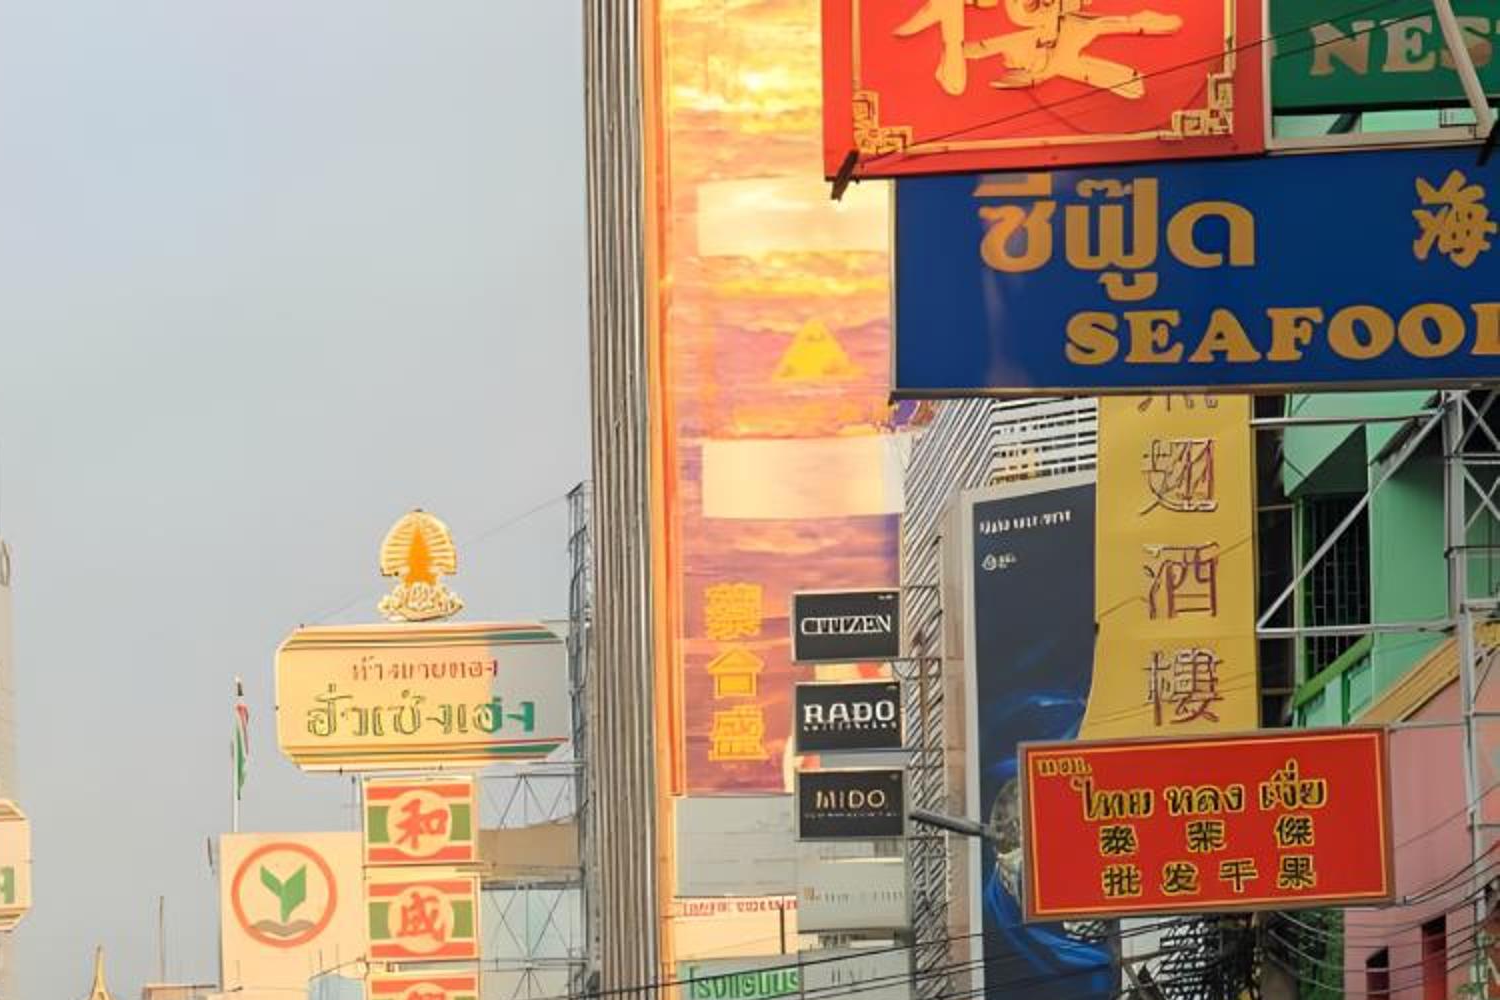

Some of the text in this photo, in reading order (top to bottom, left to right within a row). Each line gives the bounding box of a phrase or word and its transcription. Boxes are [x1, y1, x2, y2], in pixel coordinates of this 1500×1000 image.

[1310, 15, 1500, 75] NES
[1139, 394, 1220, 726] 翅酒樓
[802, 615, 891, 635] CITIZEN
[804, 700, 895, 723] RADO
[816, 789, 885, 809] MIDO
